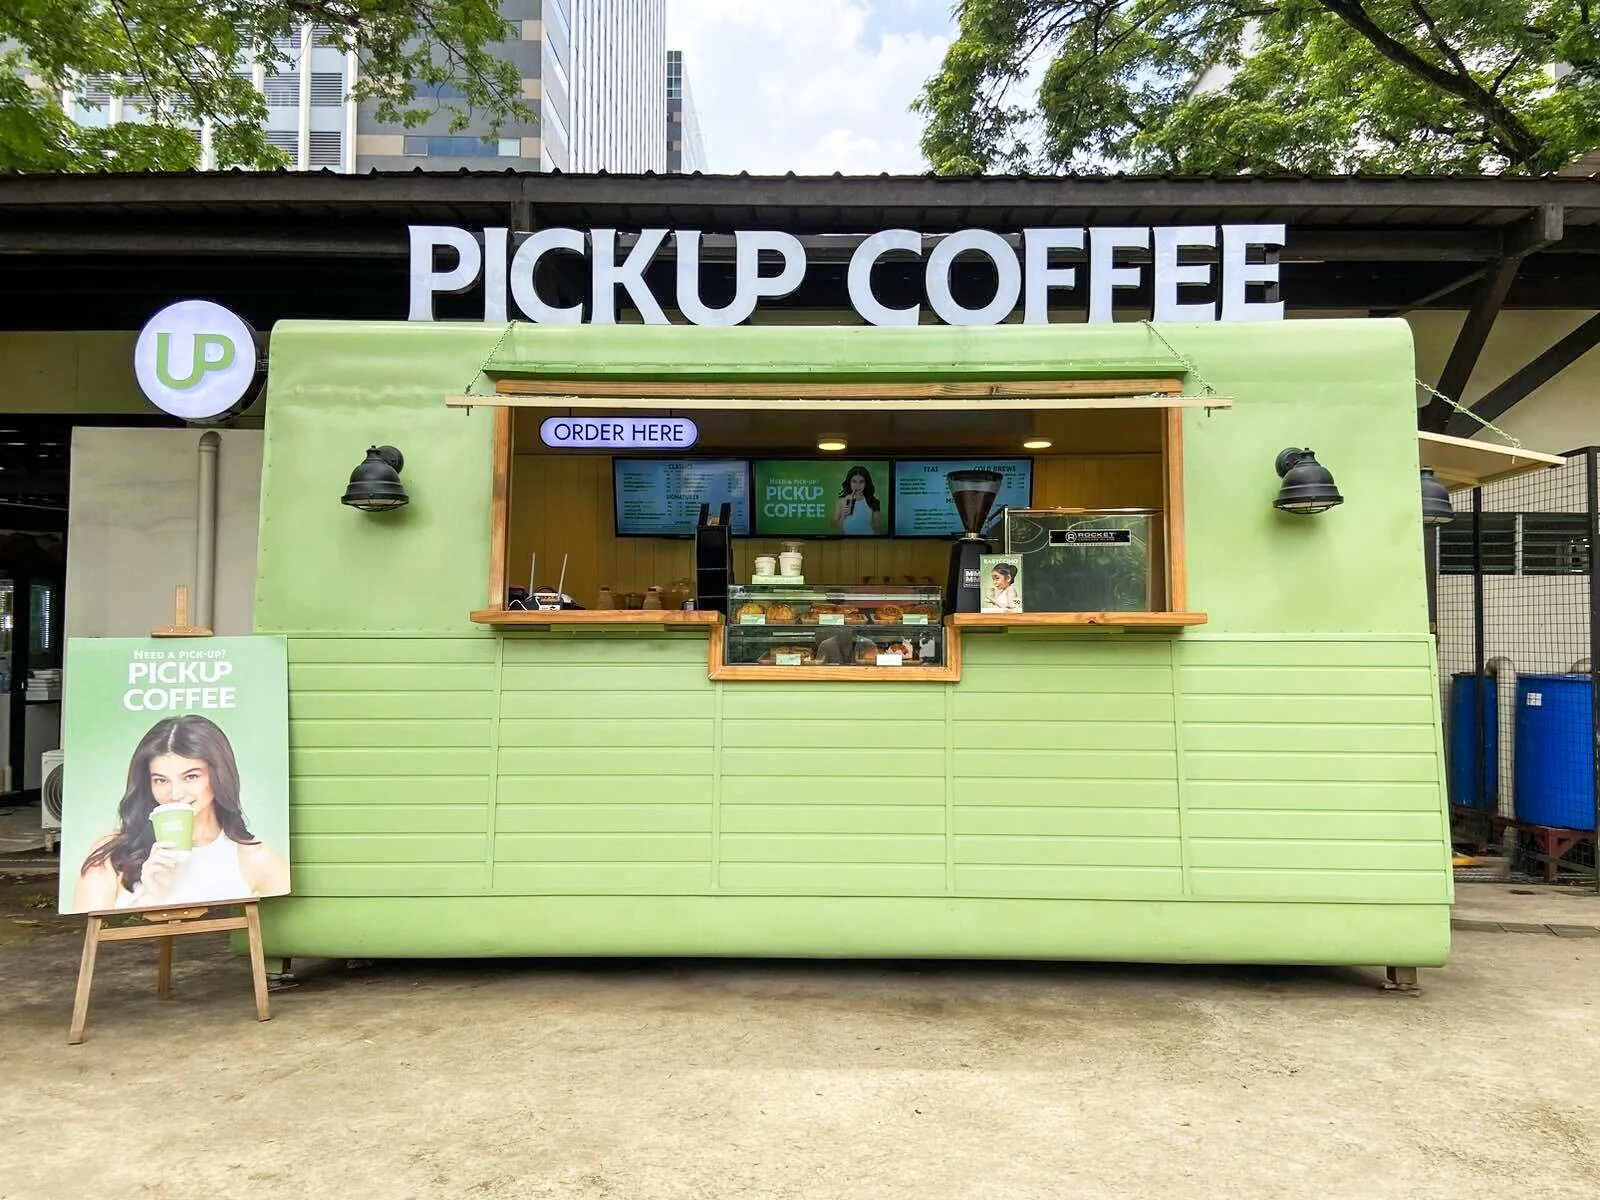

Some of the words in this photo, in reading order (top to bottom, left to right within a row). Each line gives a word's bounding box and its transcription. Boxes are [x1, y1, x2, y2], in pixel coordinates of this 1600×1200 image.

[408, 225, 807, 326] PICKUP
[847, 224, 1286, 326] COFFEE
[156, 332, 235, 390] UP
[554, 423, 624, 441] ORDER
[632, 424, 683, 441] HERE
[766, 486, 825, 501] PICKUP
[764, 503, 826, 518] COFFEE
[168, 651, 176, 659] A
[179, 649, 227, 660] PICK-UP?
[128, 661, 233, 684] PICKUP
[123, 687, 236, 711] COFFEE
